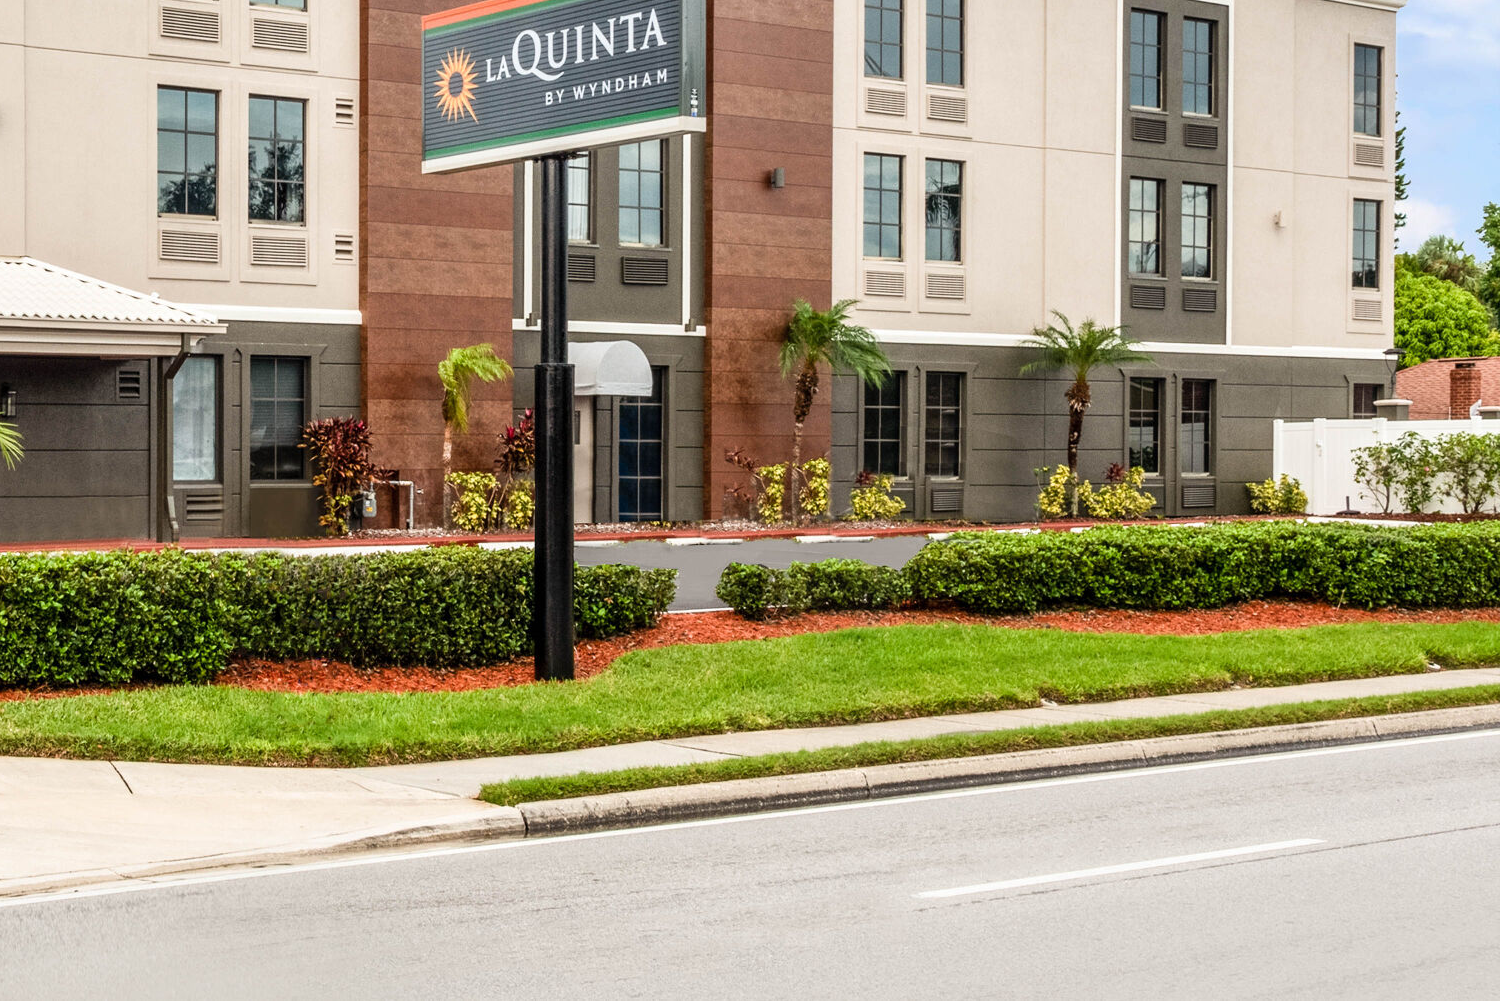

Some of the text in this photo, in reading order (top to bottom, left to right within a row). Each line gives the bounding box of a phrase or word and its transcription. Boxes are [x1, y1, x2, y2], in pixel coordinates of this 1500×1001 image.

[485, 8, 668, 83] LA QUINTA
[545, 68, 668, 106] BY WYNDHAM
